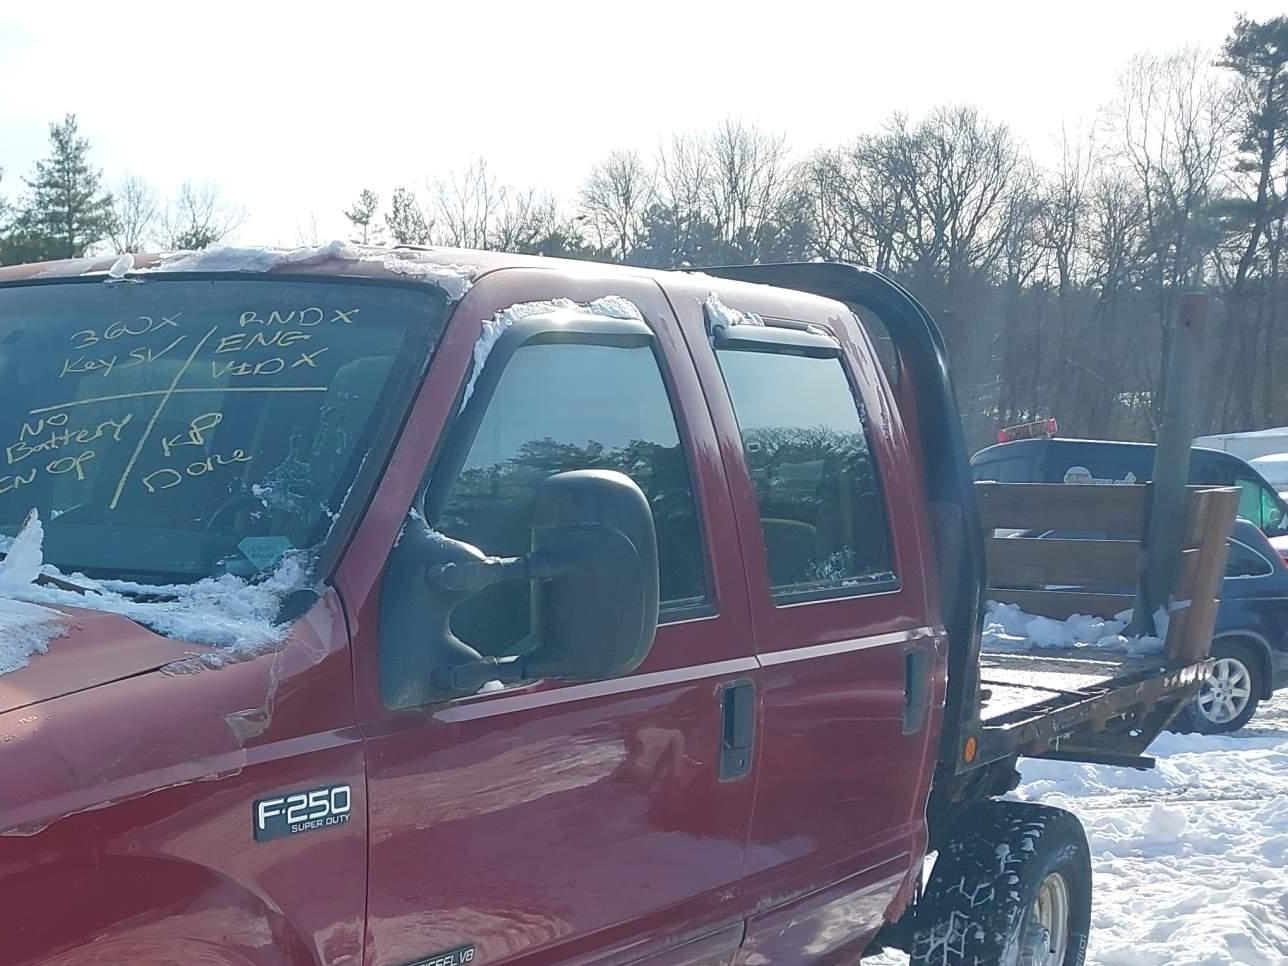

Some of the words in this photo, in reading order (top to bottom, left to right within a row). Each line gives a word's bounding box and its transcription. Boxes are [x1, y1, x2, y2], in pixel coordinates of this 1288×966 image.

[239, 308, 323, 328] RND
[330, 308, 360, 324] X
[215, 331, 312, 354] ENG
[212, 358, 284, 378] VID
[291, 347, 329, 369] X
[20, 413, 69, 441] NO
[142, 449, 253, 494] Done
[291, 819, 324, 833] SUPER
[325, 813, 351, 826] DUTY
[459, 948, 474, 964] V8
